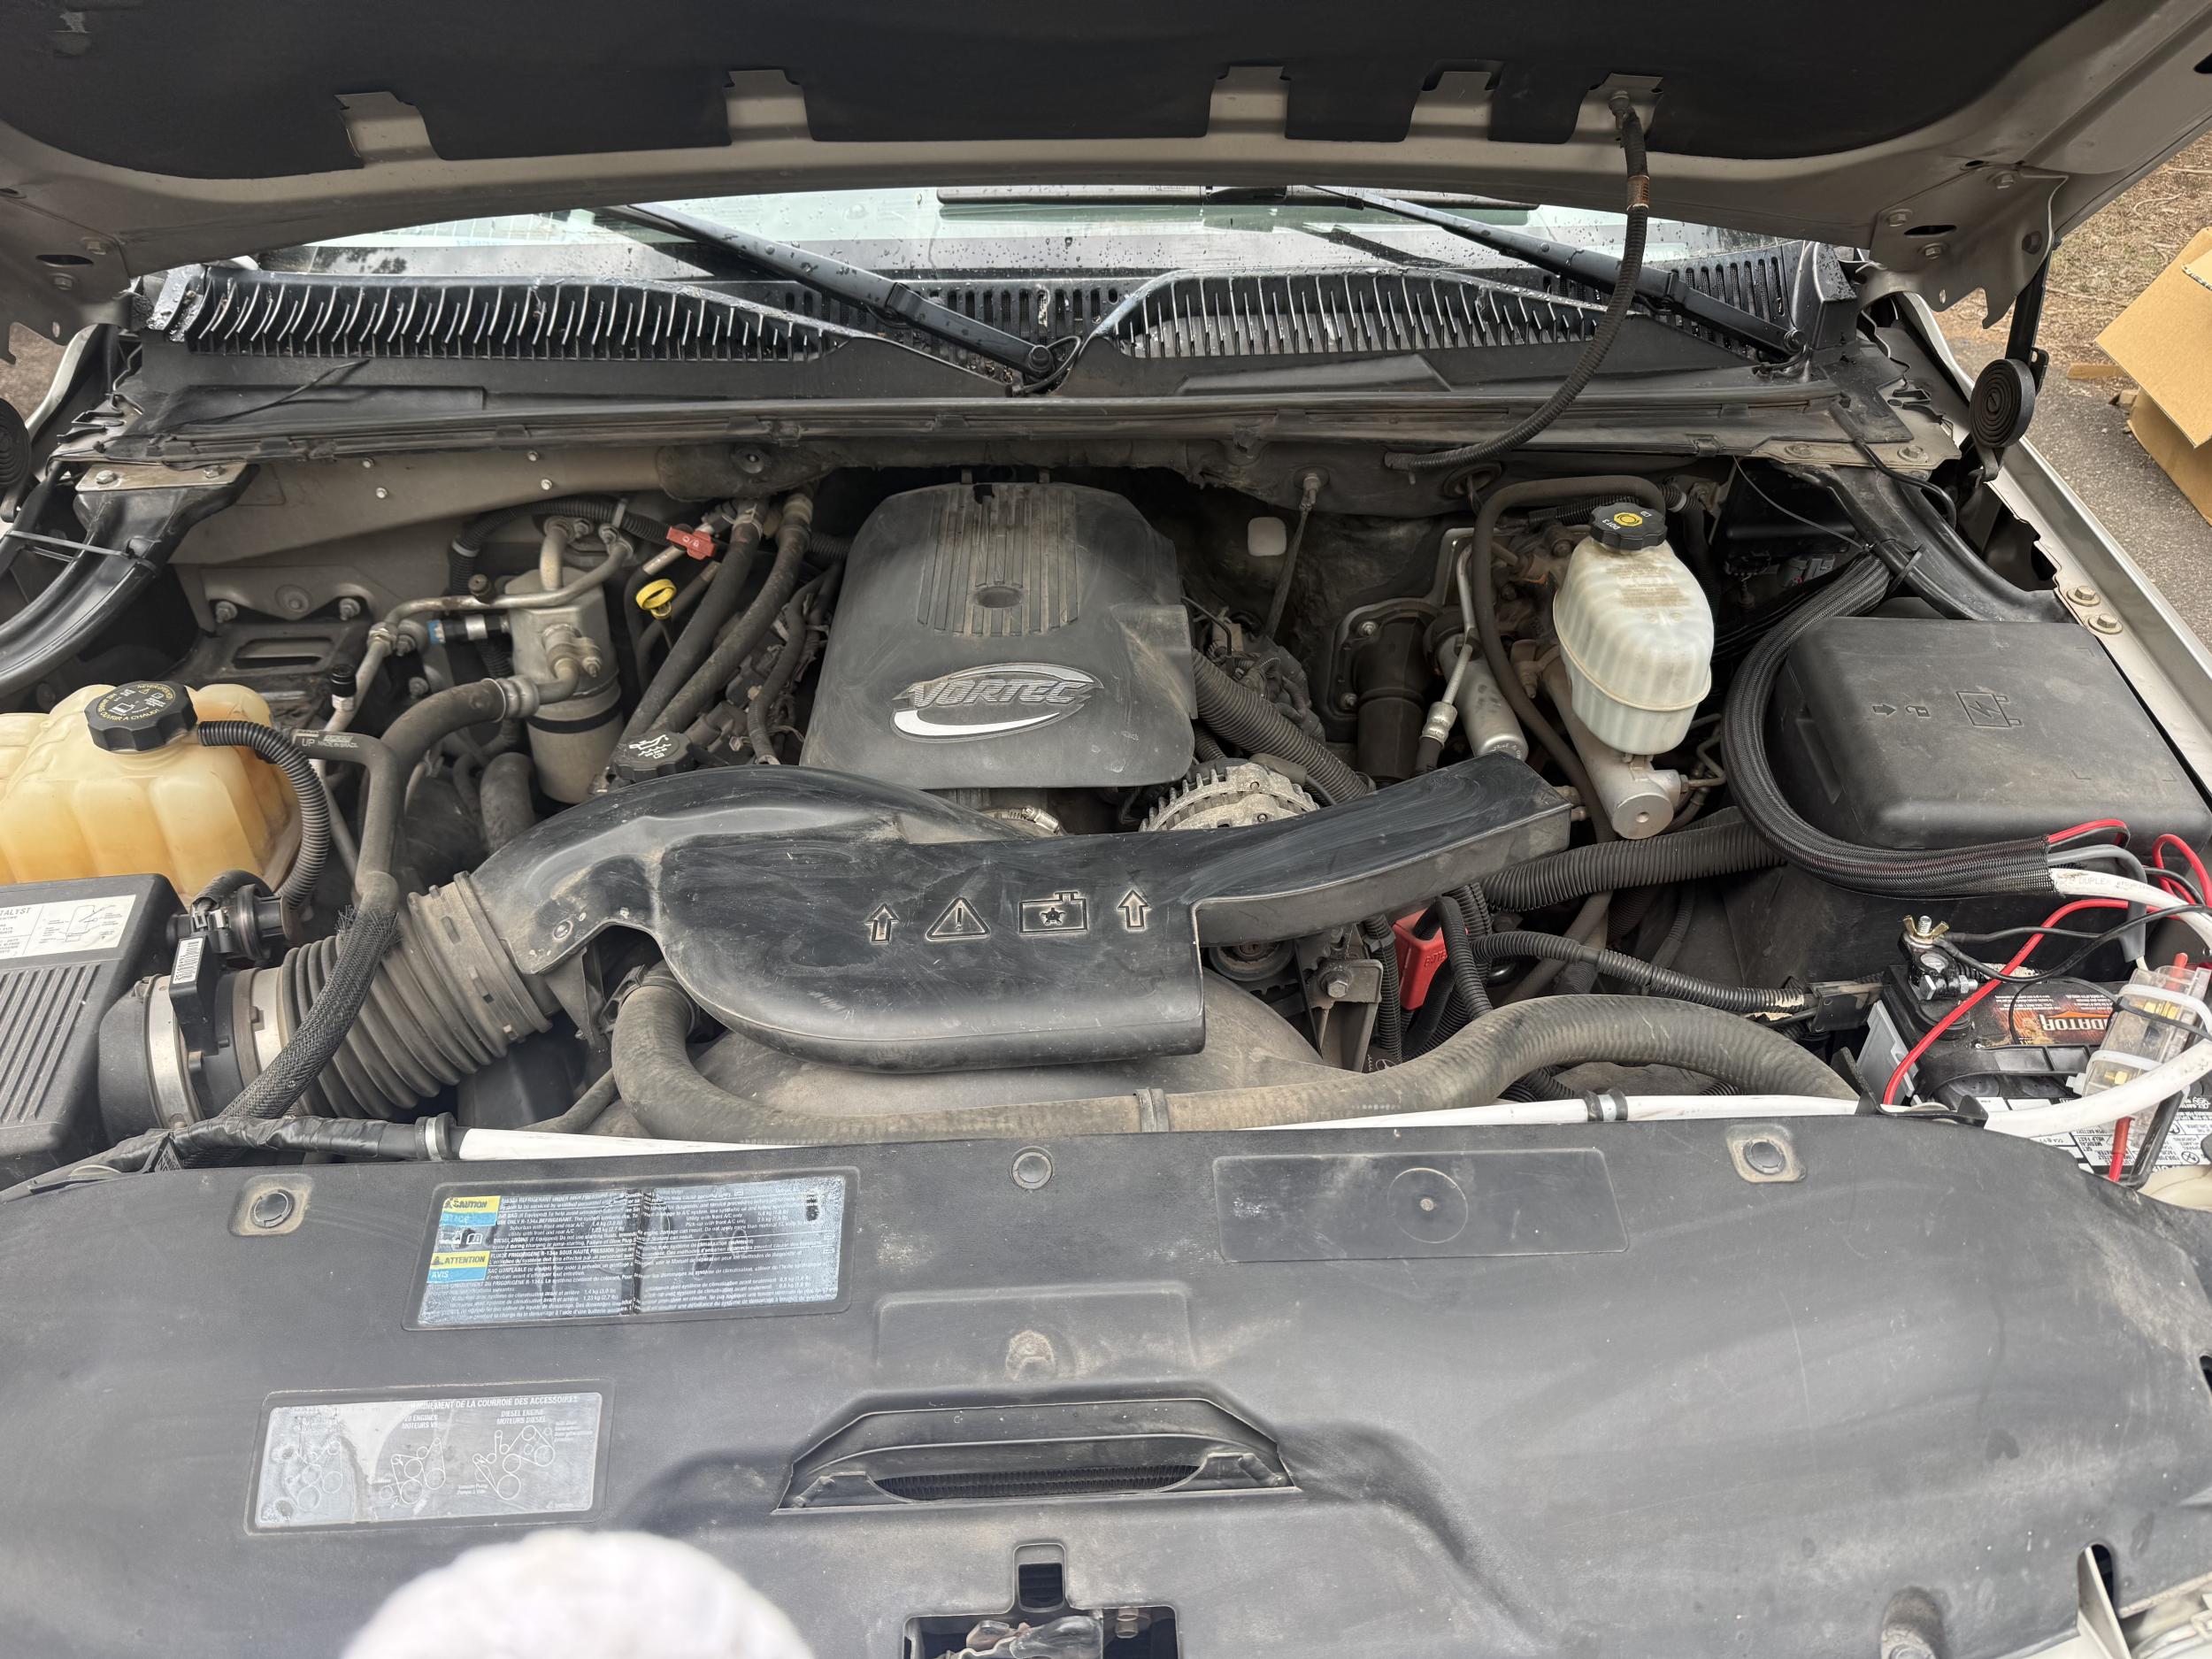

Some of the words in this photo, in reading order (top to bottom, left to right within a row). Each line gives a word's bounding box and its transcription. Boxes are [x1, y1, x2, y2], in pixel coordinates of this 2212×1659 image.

[913, 679, 1088, 709] VORTEC
[302, 738, 315, 747] UP
[0, 907, 33, 916] TALYST
